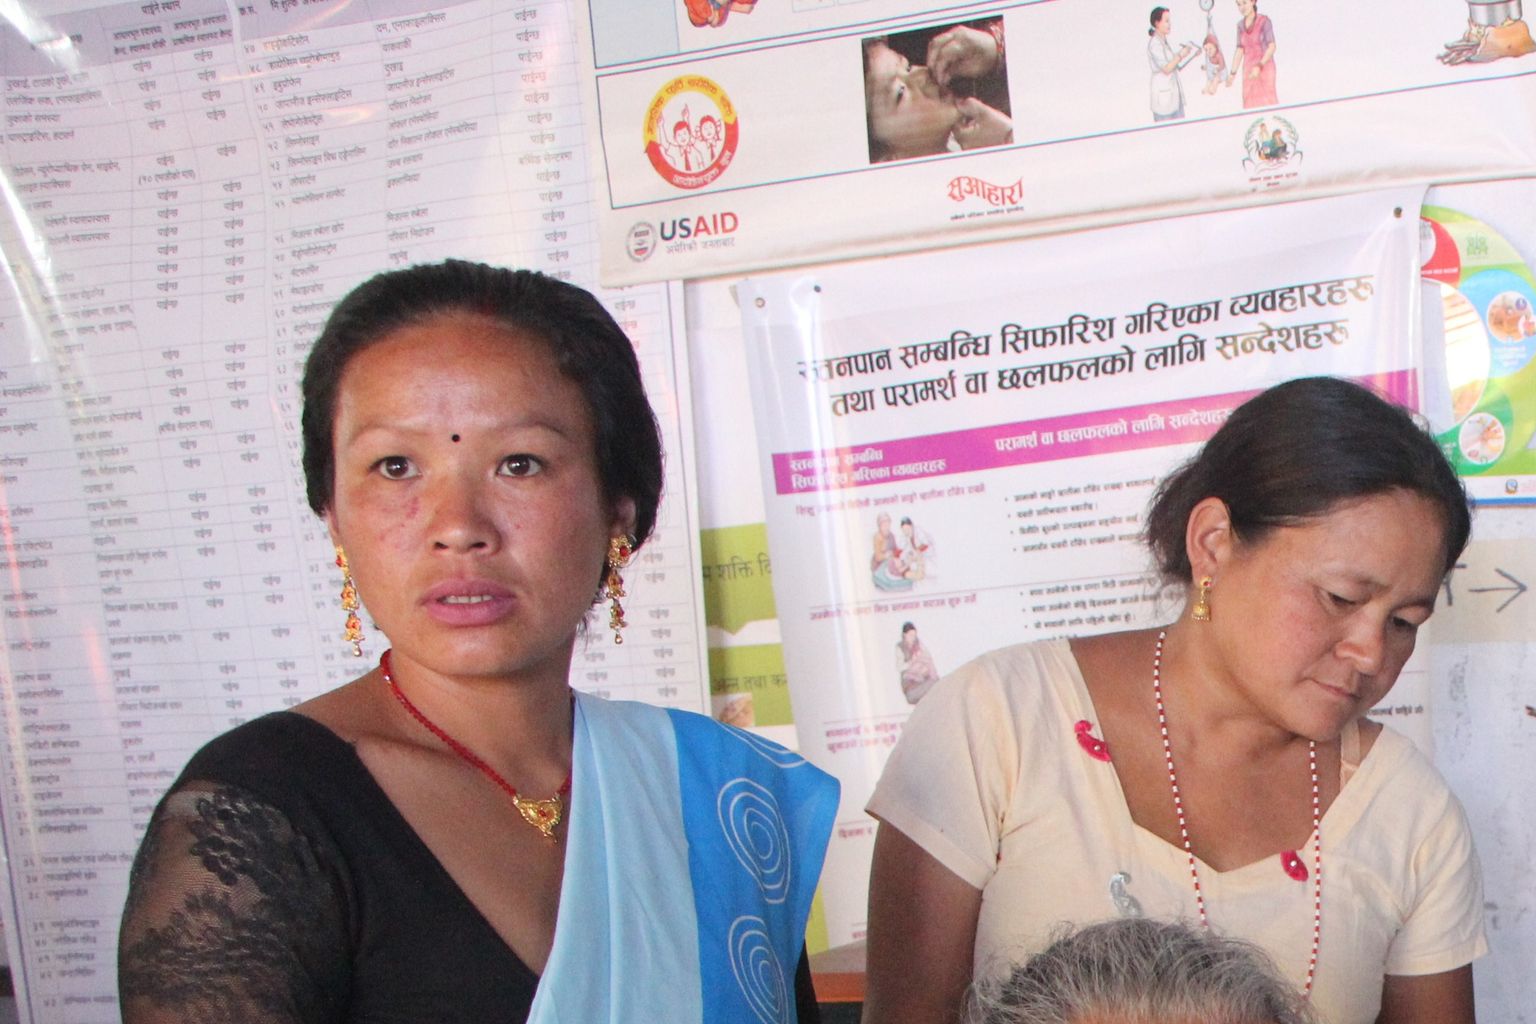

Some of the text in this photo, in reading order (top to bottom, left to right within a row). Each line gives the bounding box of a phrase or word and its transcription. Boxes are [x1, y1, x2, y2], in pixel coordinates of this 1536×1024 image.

[660, 211, 739, 241] USAID
[1000, 314, 1117, 355] सिफारिश
[1125, 300, 1223, 335] गरिएका
[830, 386, 875, 418] तथा
[882, 370, 957, 409] परामर्श
[965, 371, 989, 396] वा
[997, 345, 1135, 391] छलफलको
[1145, 333, 1207, 371] लागि
